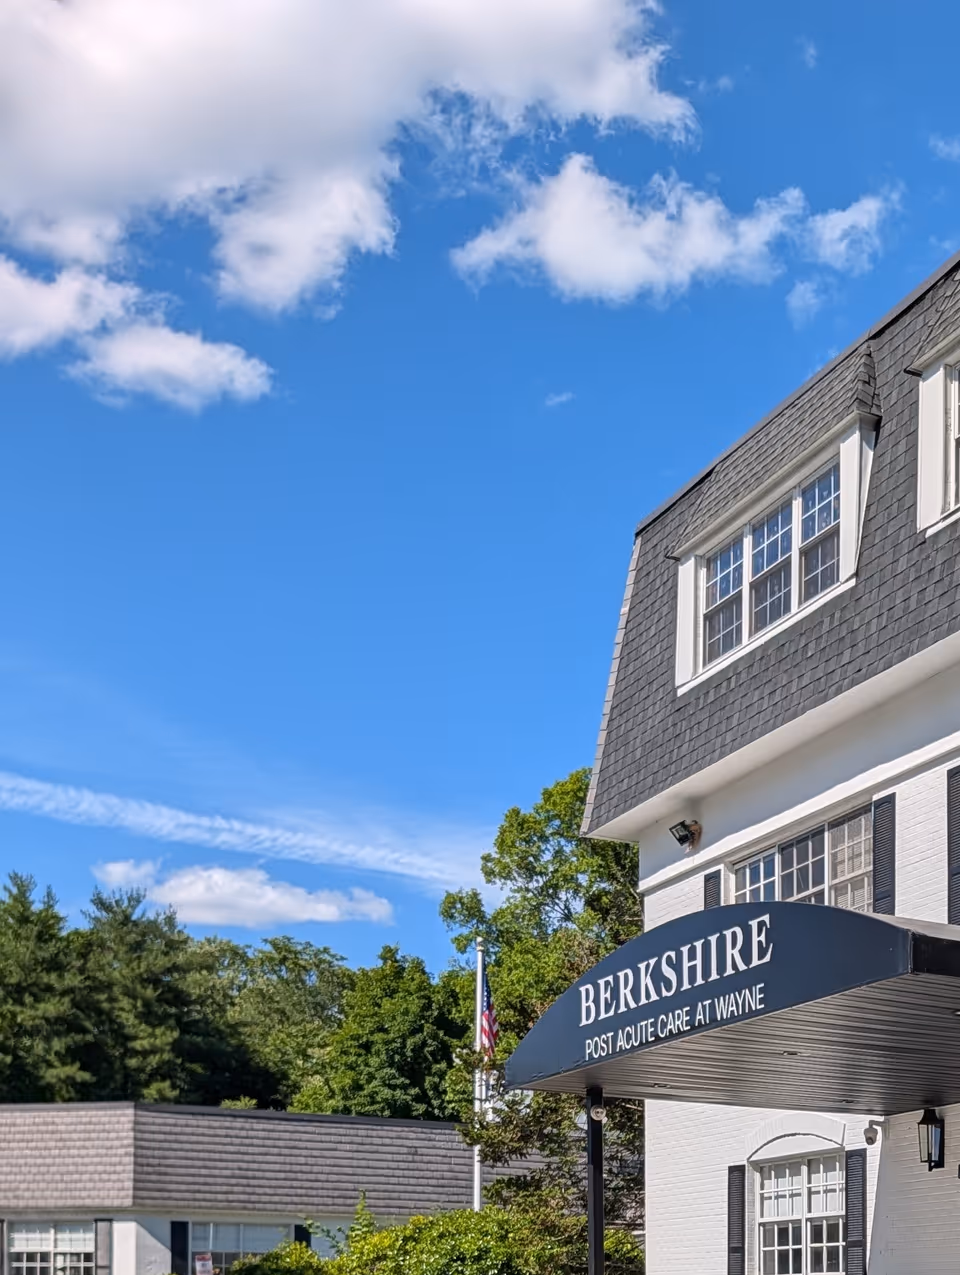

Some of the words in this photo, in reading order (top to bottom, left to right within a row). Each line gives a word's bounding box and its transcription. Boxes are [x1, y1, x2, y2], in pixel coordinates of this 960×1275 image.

[578, 913, 773, 1028] BERKSHIRE
[585, 1031, 614, 1061] POST
[616, 1018, 655, 1052] ACUTE
[657, 1006, 691, 1038] CARE
[695, 999, 712, 1027] AT
[715, 983, 765, 1021] WAYNE
